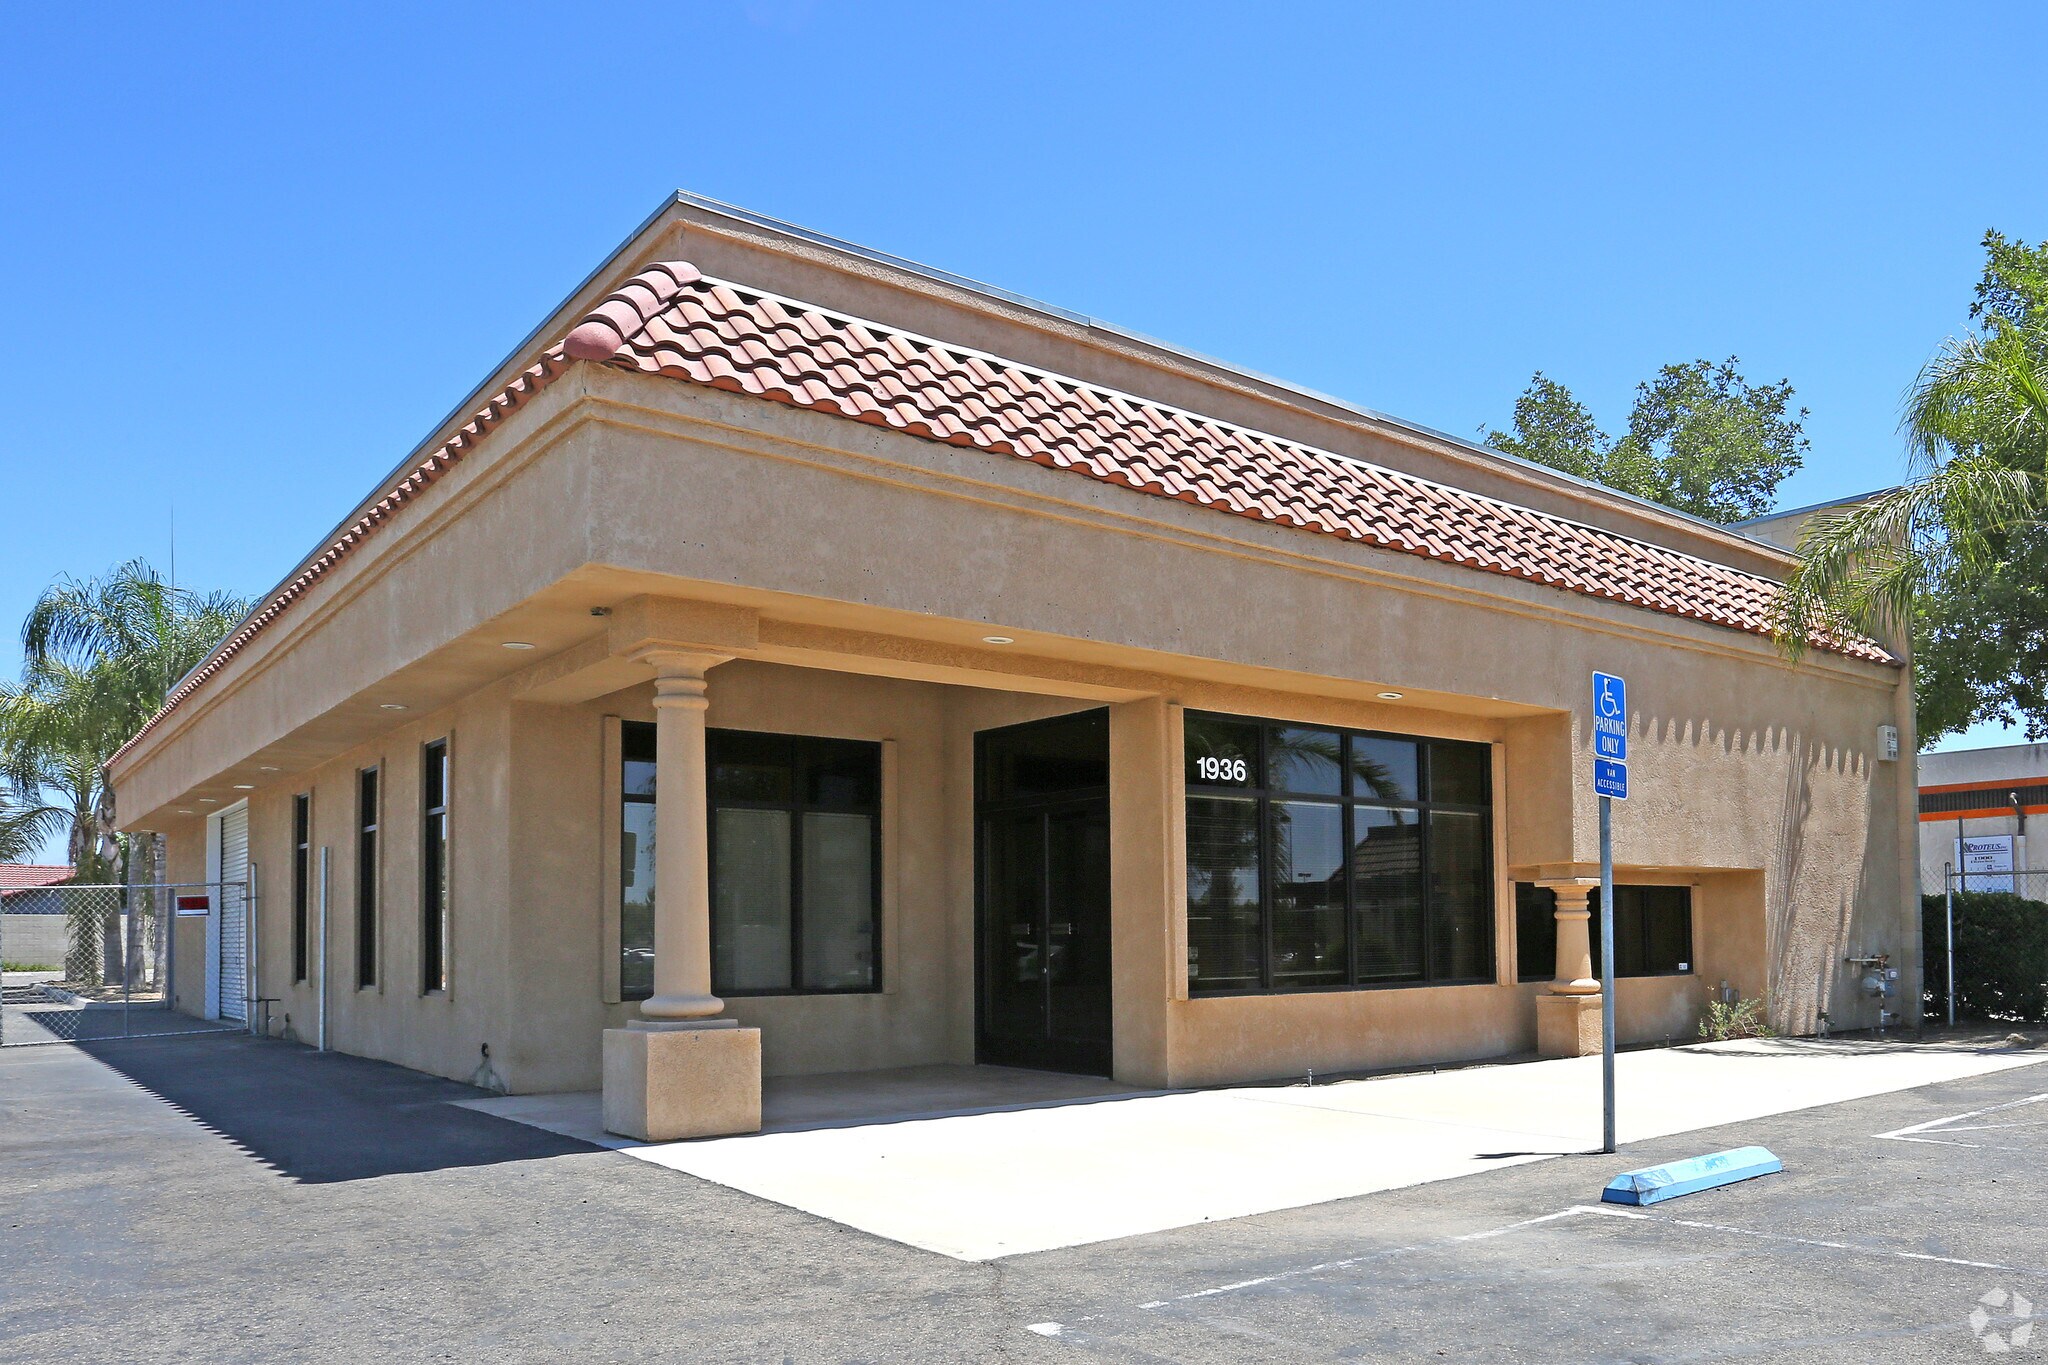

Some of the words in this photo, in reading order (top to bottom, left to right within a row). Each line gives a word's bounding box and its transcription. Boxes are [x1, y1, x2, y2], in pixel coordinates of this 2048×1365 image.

[1595, 715, 1625, 736] PARKING
[1602, 736, 1620, 754] ONLY
[1196, 756, 1246, 782] 1936
[1607, 768, 1616, 778] VAN
[1597, 779, 1625, 791] ACCESSIBLE
